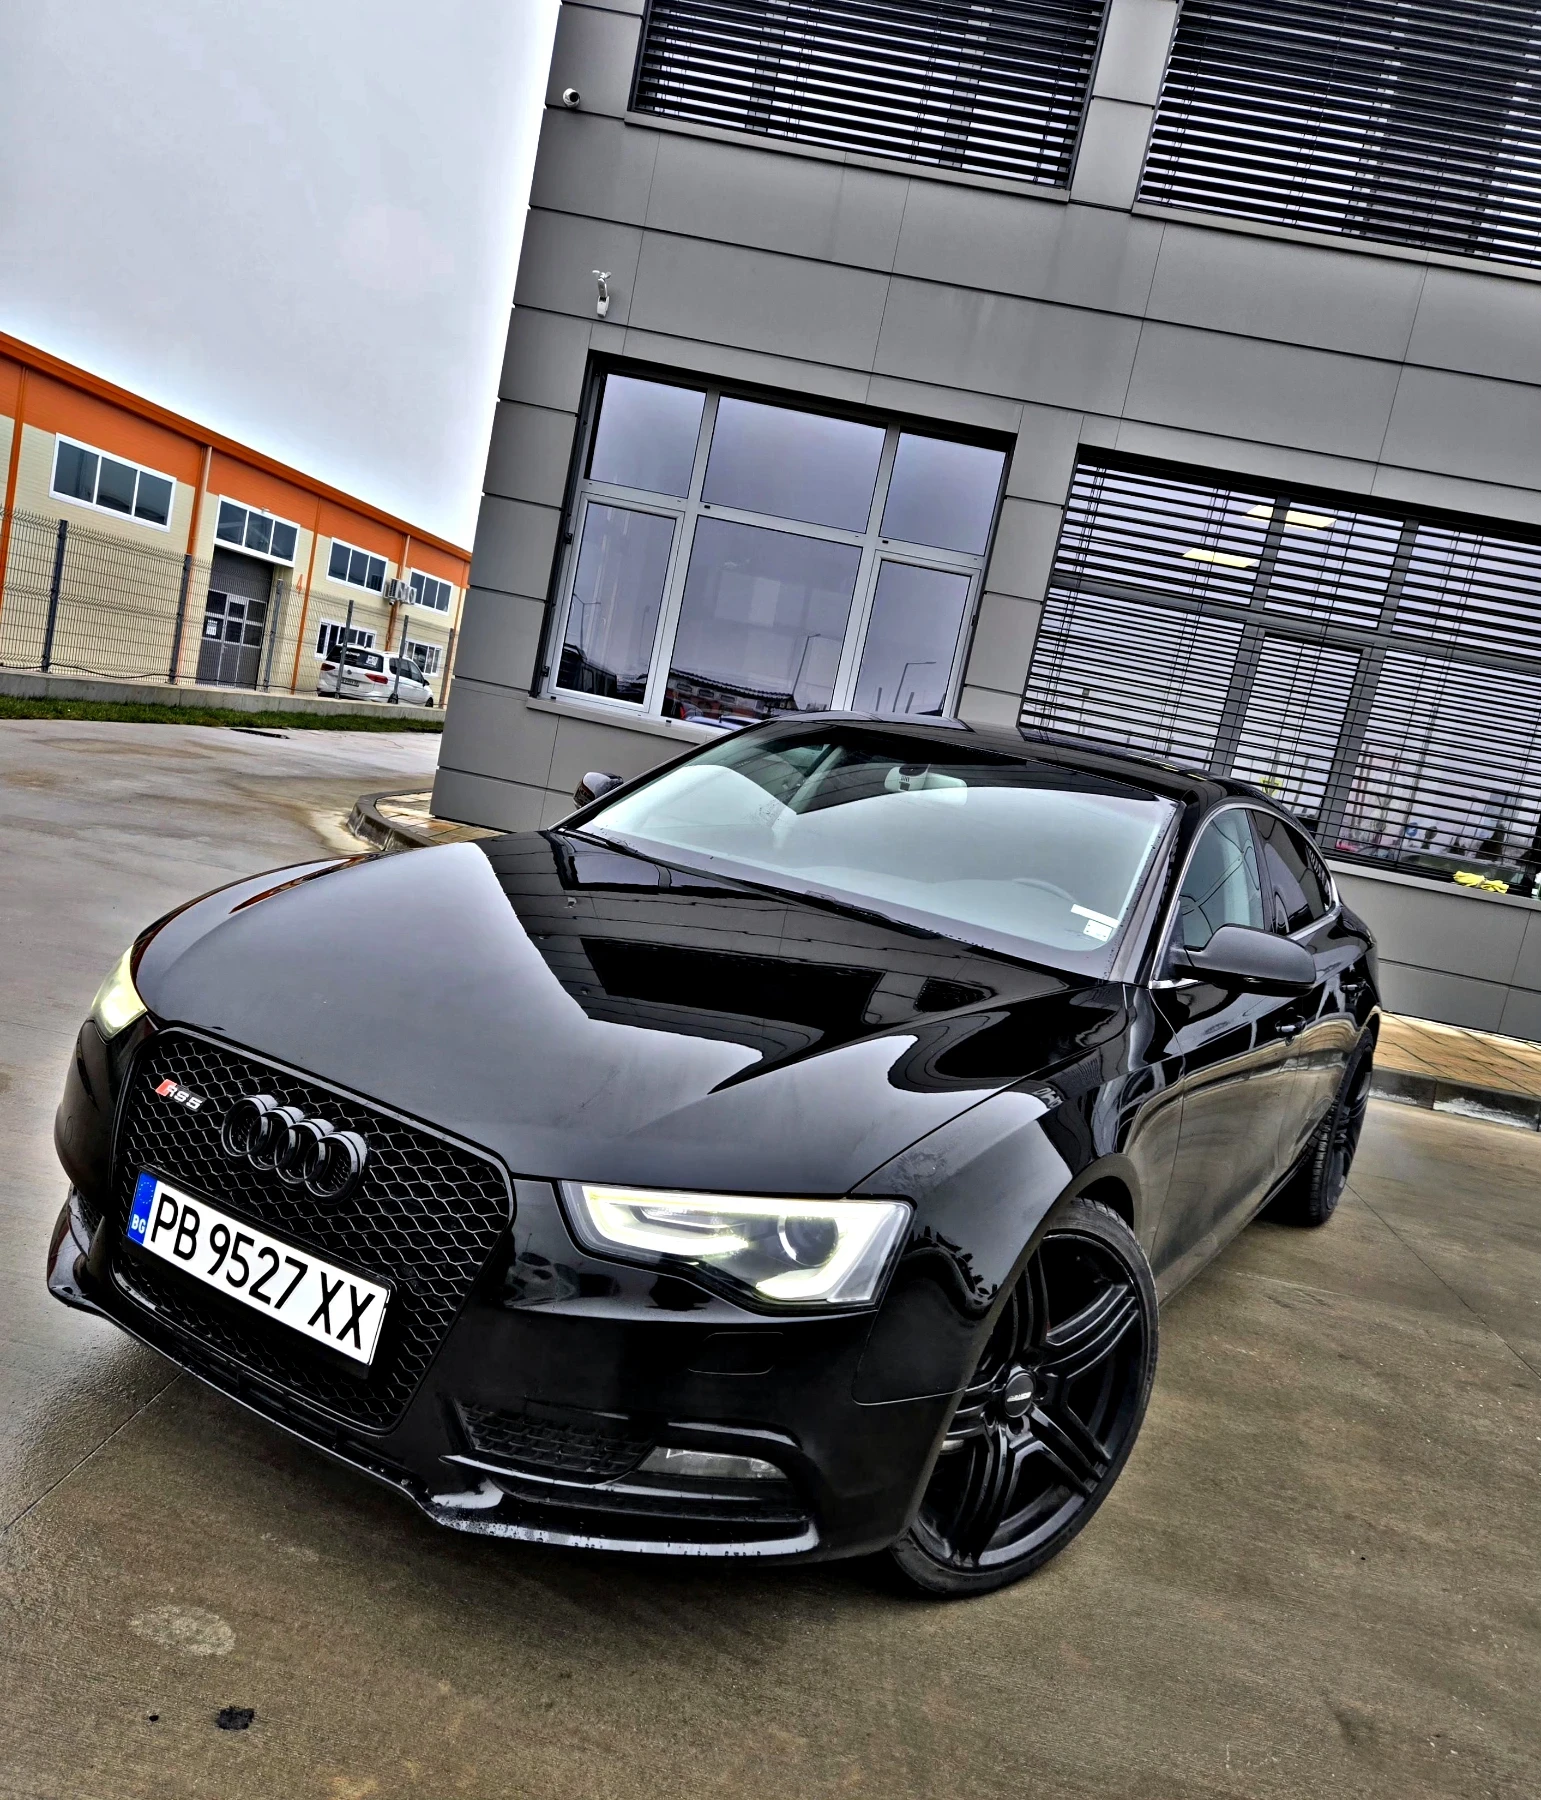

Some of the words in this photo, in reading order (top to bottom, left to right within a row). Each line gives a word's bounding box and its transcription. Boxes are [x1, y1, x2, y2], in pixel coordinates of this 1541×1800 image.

[131, 1213, 146, 1234] BG
[150, 1192, 201, 1261] PB
[206, 1223, 309, 1310] 9527
[307, 1271, 376, 1350] XX
